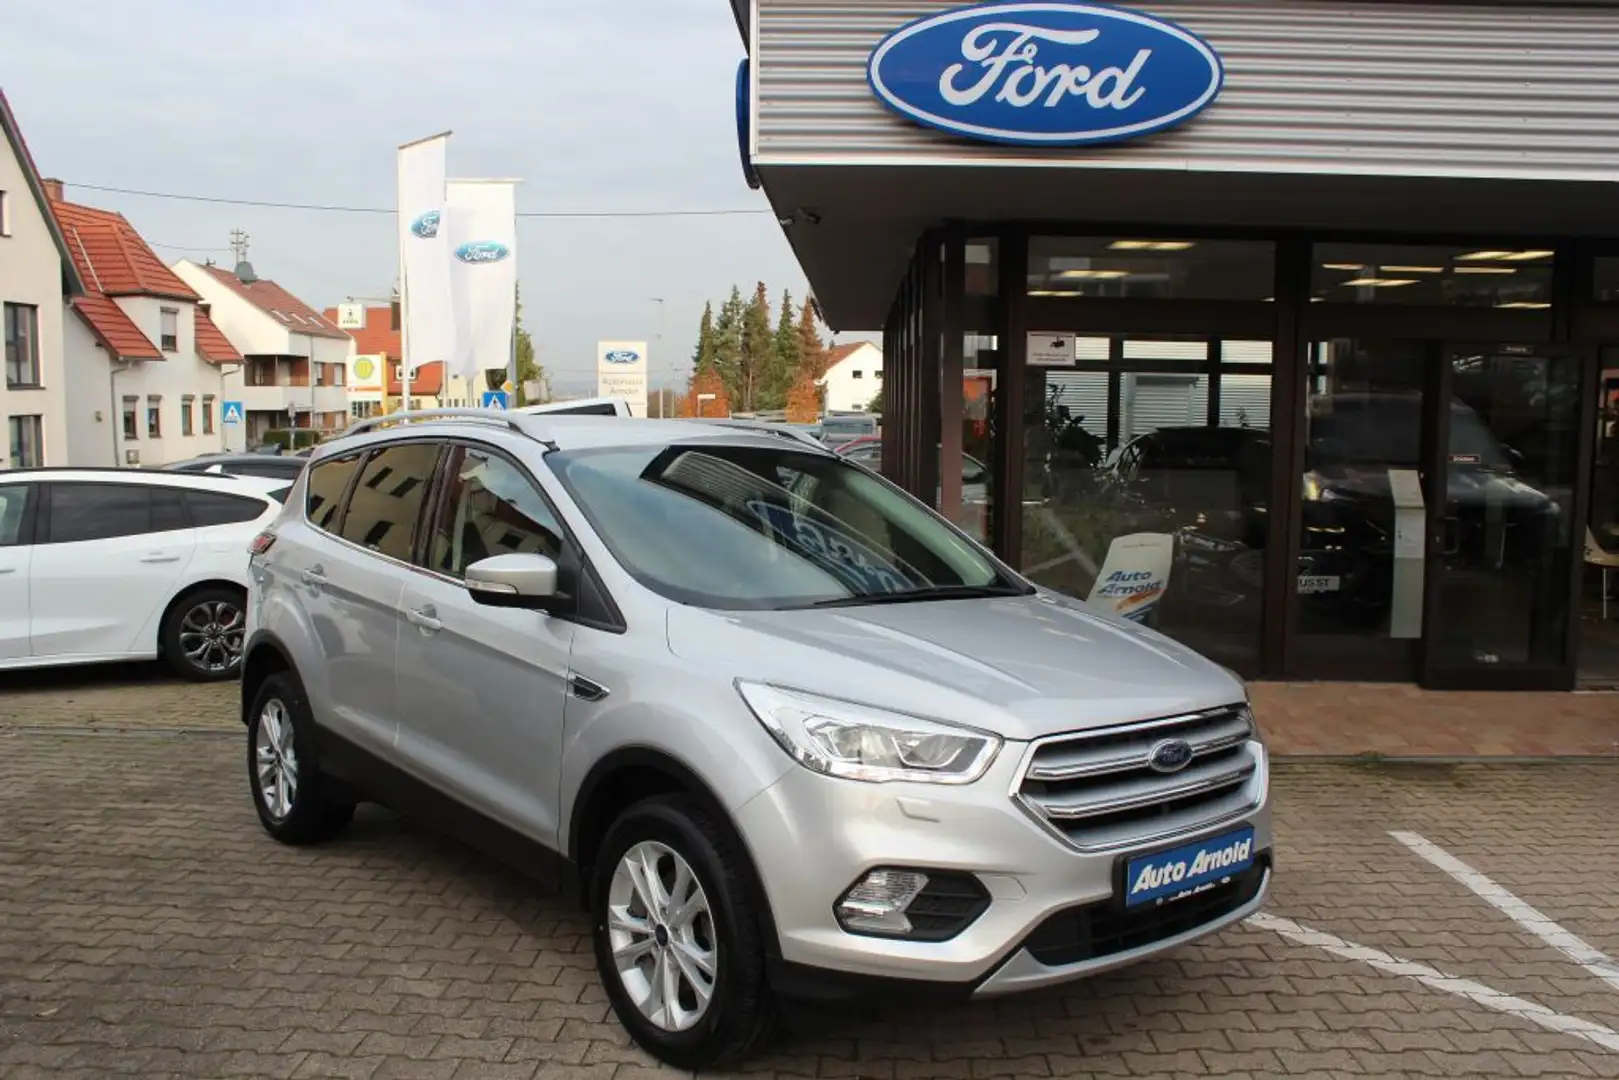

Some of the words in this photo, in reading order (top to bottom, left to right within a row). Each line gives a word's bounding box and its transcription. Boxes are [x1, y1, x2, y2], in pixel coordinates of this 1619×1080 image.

[939, 22, 1152, 110] Ford
[464, 244, 500, 261] Ford
[1106, 570, 1152, 582] Auto
[1097, 580, 1162, 594] Arnold
[1131, 860, 1187, 894] Auto
[1187, 838, 1251, 878] Arnold
